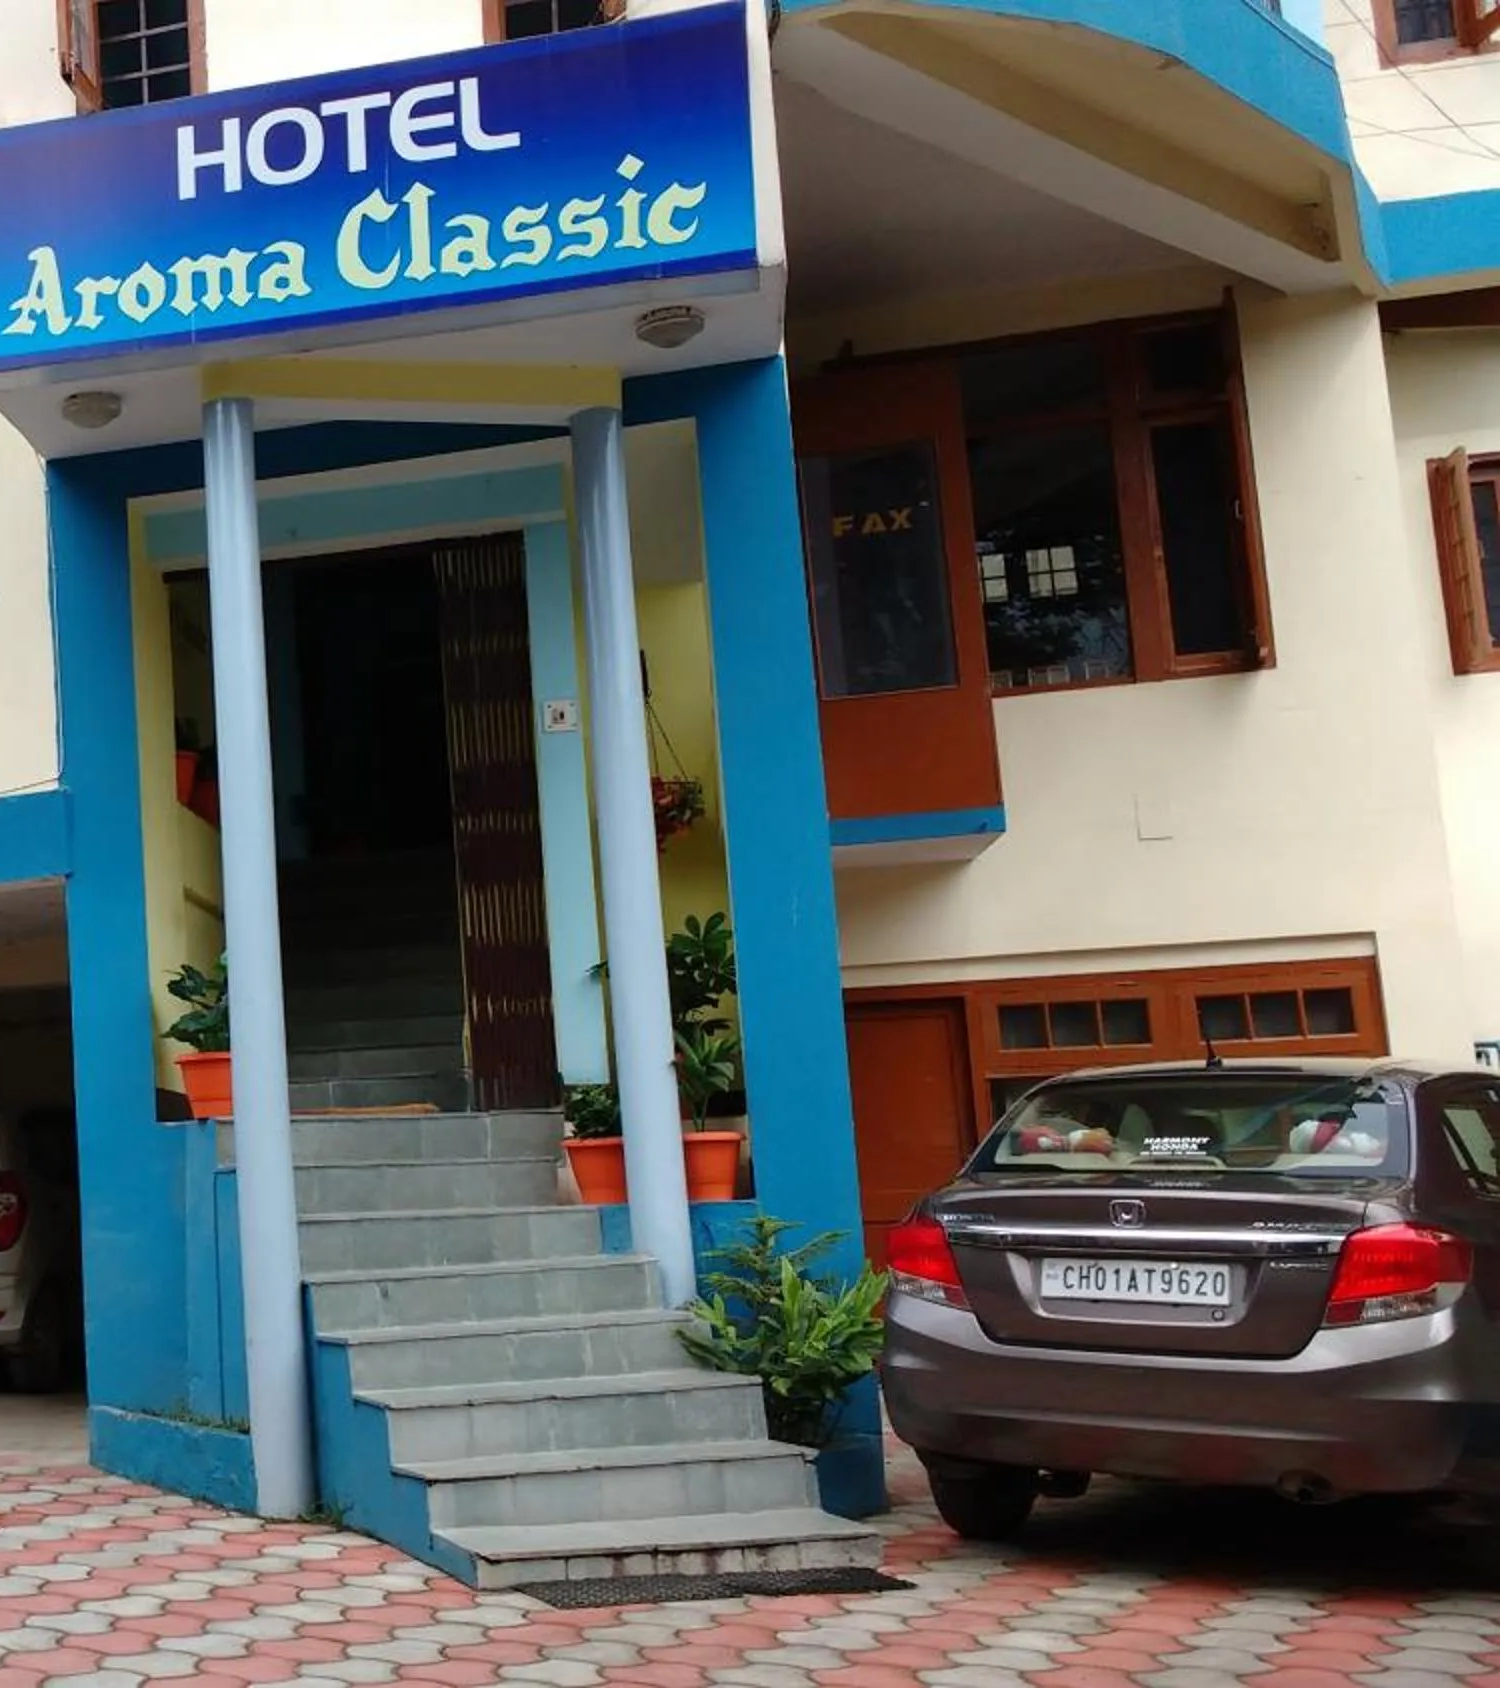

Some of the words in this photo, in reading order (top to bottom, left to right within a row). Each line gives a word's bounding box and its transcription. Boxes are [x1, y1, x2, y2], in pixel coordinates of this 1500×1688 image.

[177, 77, 520, 201] HOTEL
[2, 240, 313, 337] Aroma
[336, 154, 707, 290] Classic
[831, 507, 914, 538] FAX
[1062, 1264, 1227, 1298] CH01AT9620
